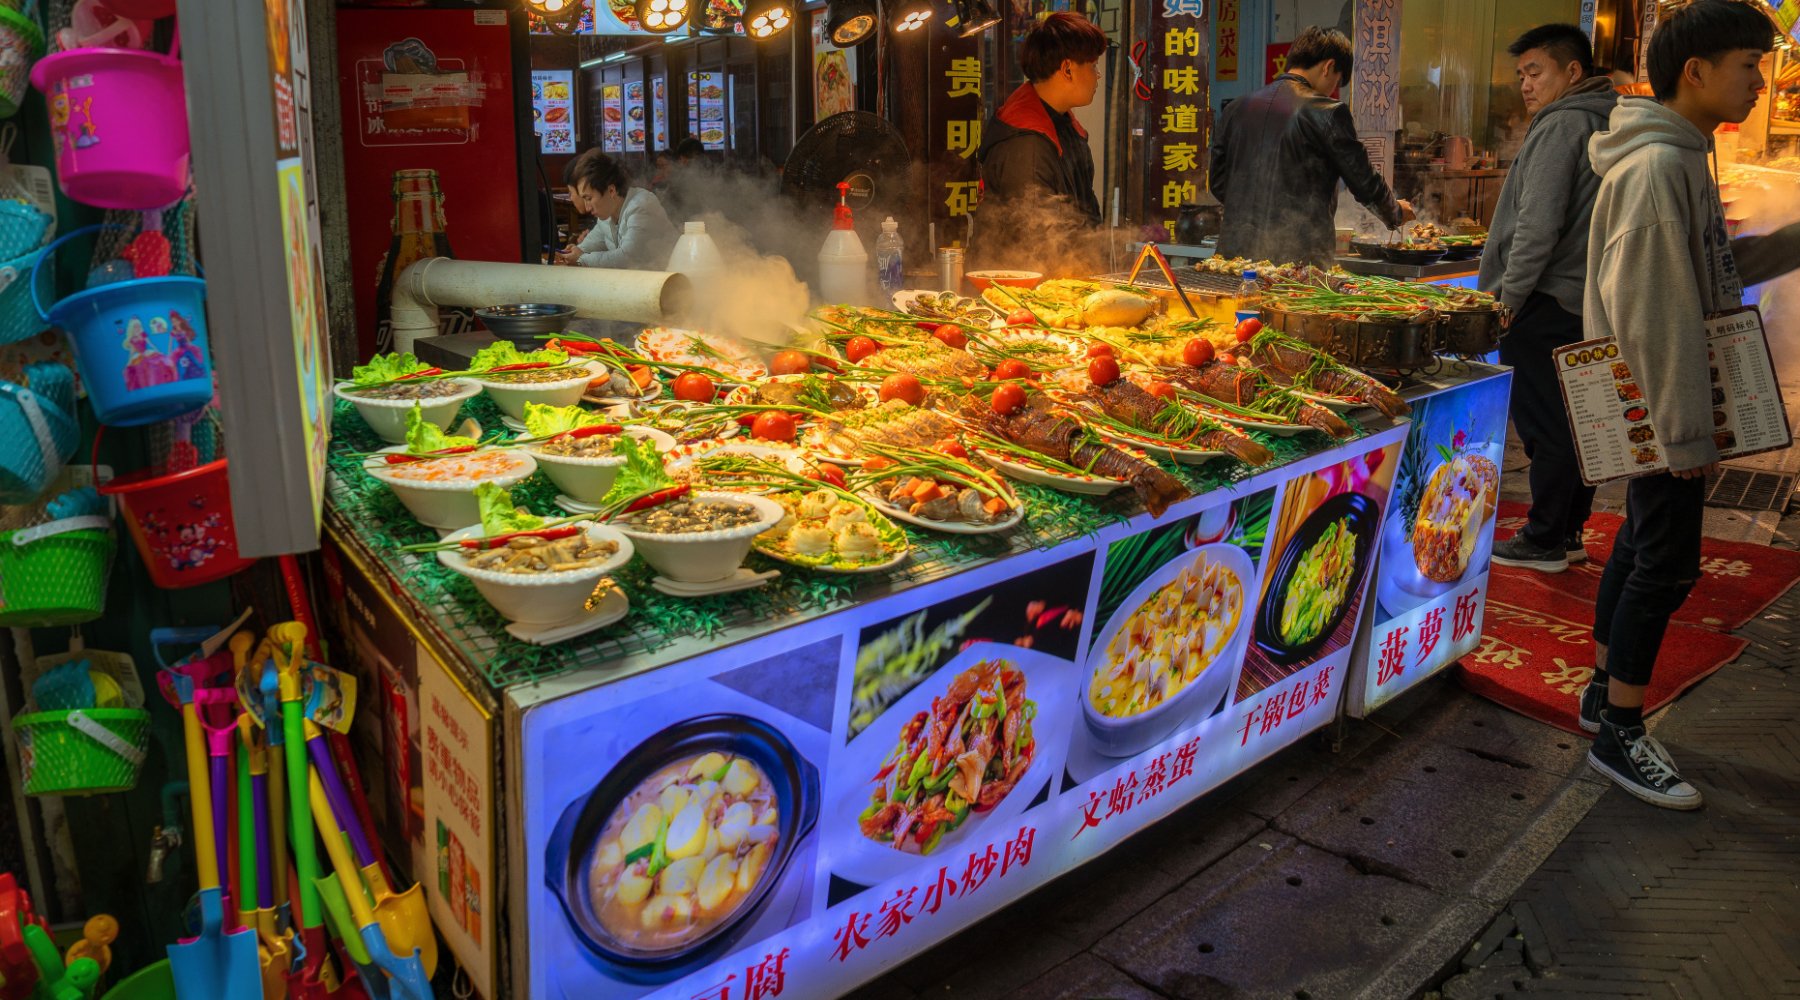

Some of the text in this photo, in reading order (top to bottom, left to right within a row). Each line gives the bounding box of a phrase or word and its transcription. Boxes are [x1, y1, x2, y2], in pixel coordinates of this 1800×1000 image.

[1361, 0, 1394, 117] 淇淋
[1377, 587, 1479, 686] 菠萝饭
[1237, 665, 1335, 747] 干锅包菜
[1071, 736, 1201, 841] 文蛤蒸蛋
[828, 826, 1037, 962] 农家小炒肉
